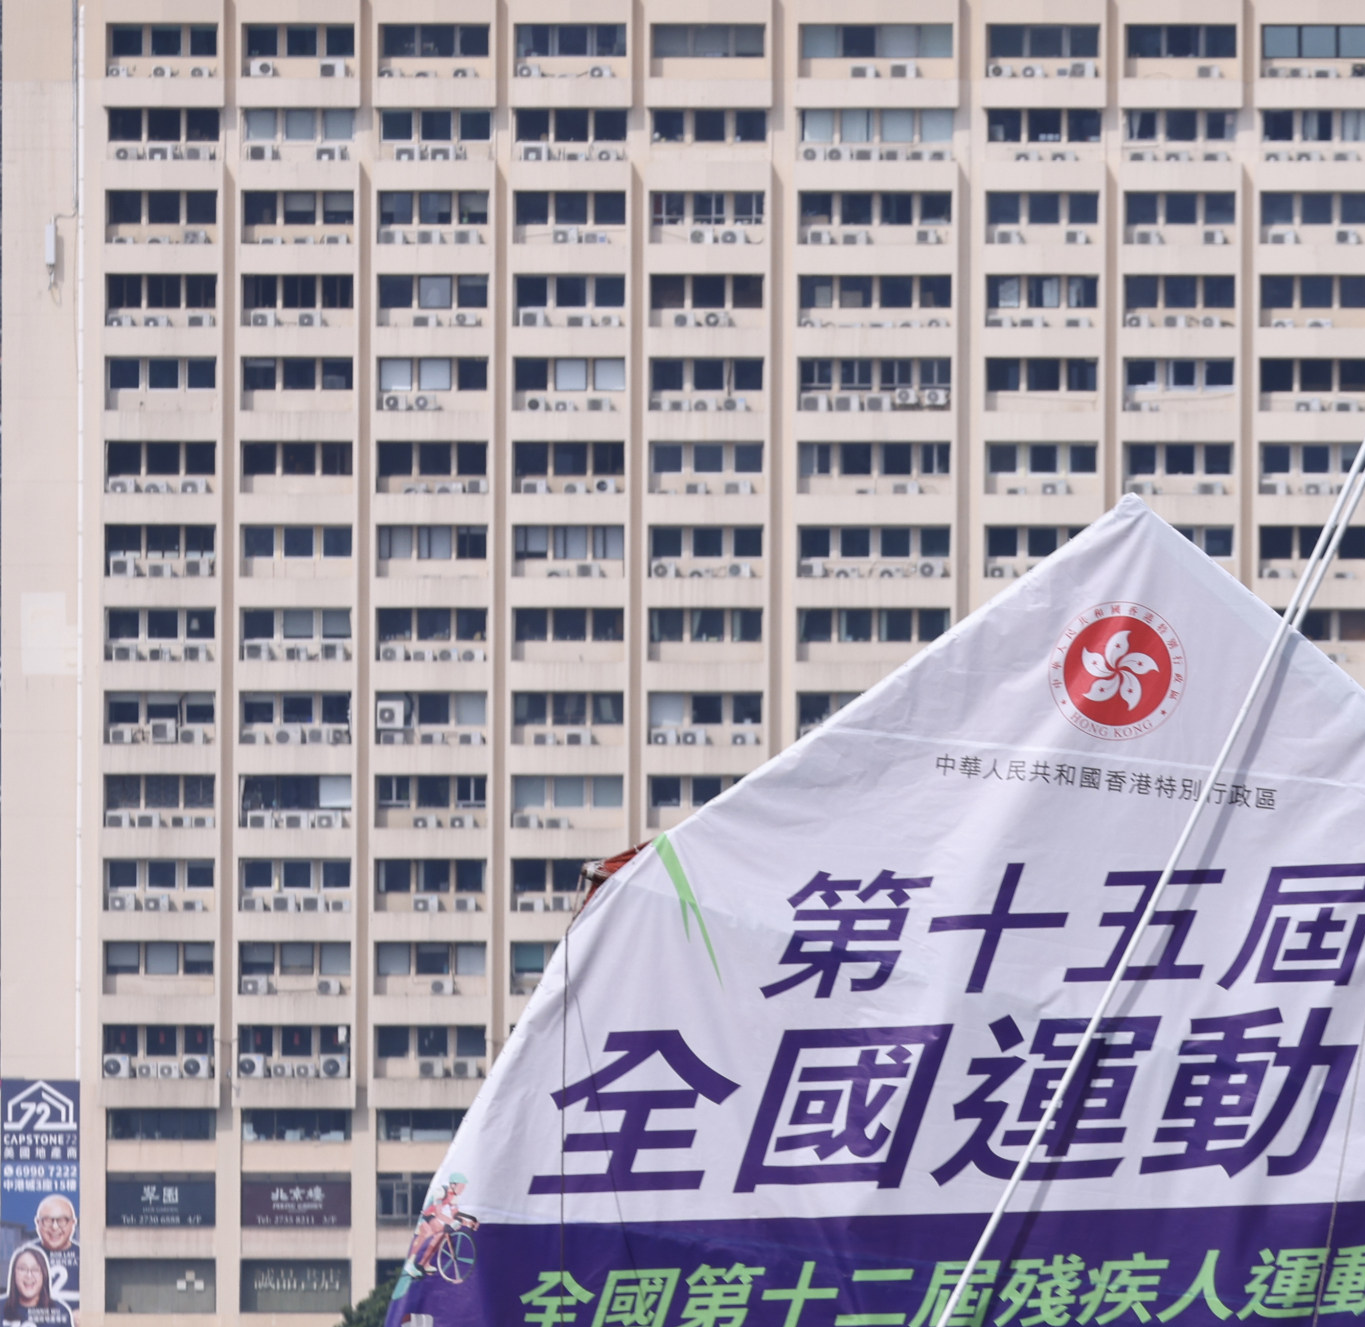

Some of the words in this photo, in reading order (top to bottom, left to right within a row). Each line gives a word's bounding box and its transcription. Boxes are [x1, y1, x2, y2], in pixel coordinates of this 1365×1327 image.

[1070, 711, 1108, 737] HONG
[1113, 719, 1153, 738] KONG
[935, 753, 1277, 810] 中華人民共和國香港特別行政區
